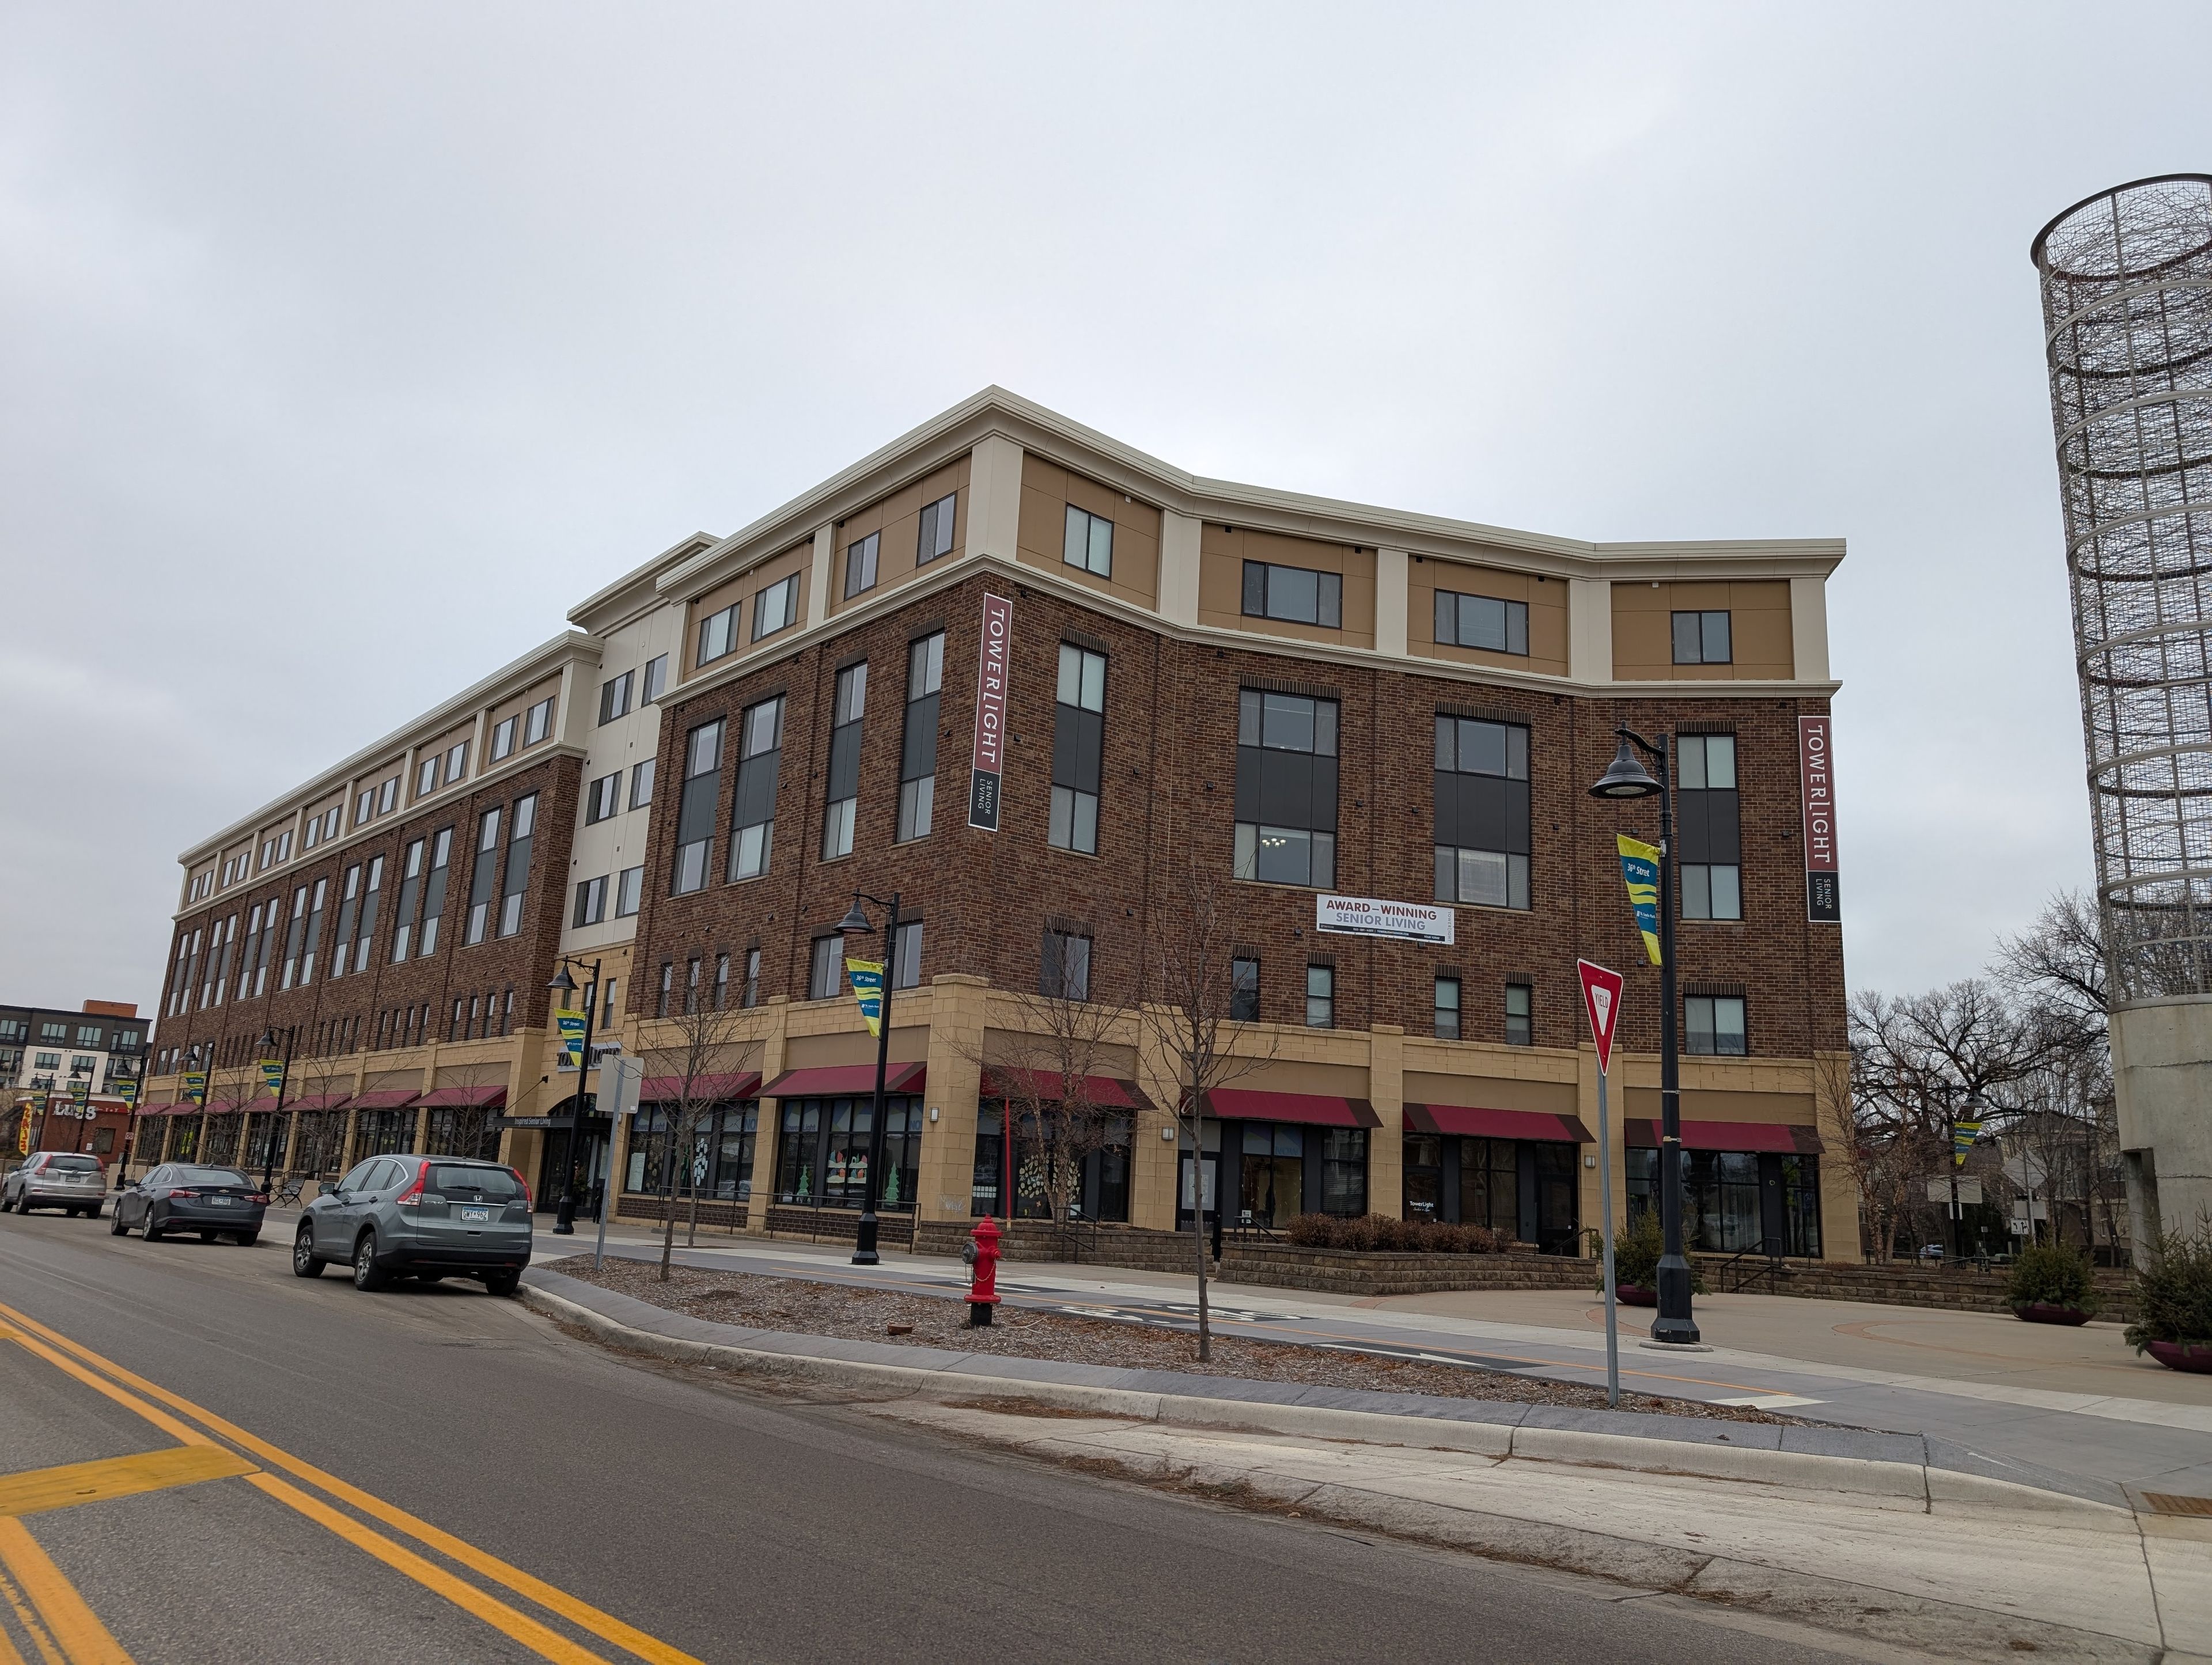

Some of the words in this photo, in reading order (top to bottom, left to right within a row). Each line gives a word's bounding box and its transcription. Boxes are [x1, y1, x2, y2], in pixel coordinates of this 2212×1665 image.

[981, 608, 1005, 763] TOWERLIGHT
[978, 778, 986, 809] LIVING
[984, 780, 993, 815] SENIOR
[1807, 725, 1831, 863] TOWERLIGHT
[1627, 863, 1636, 873] 36th
[1816, 878, 1824, 907] LIVING
[1823, 878, 1832, 909] SENIOR
[1336, 912, 1381, 927] SENIOR
[1385, 916, 1426, 931] LIVING
[1594, 993, 1608, 1008] YIELD
[514, 1118, 529, 1127] Inspired
[540, 1118, 551, 1127] Living
